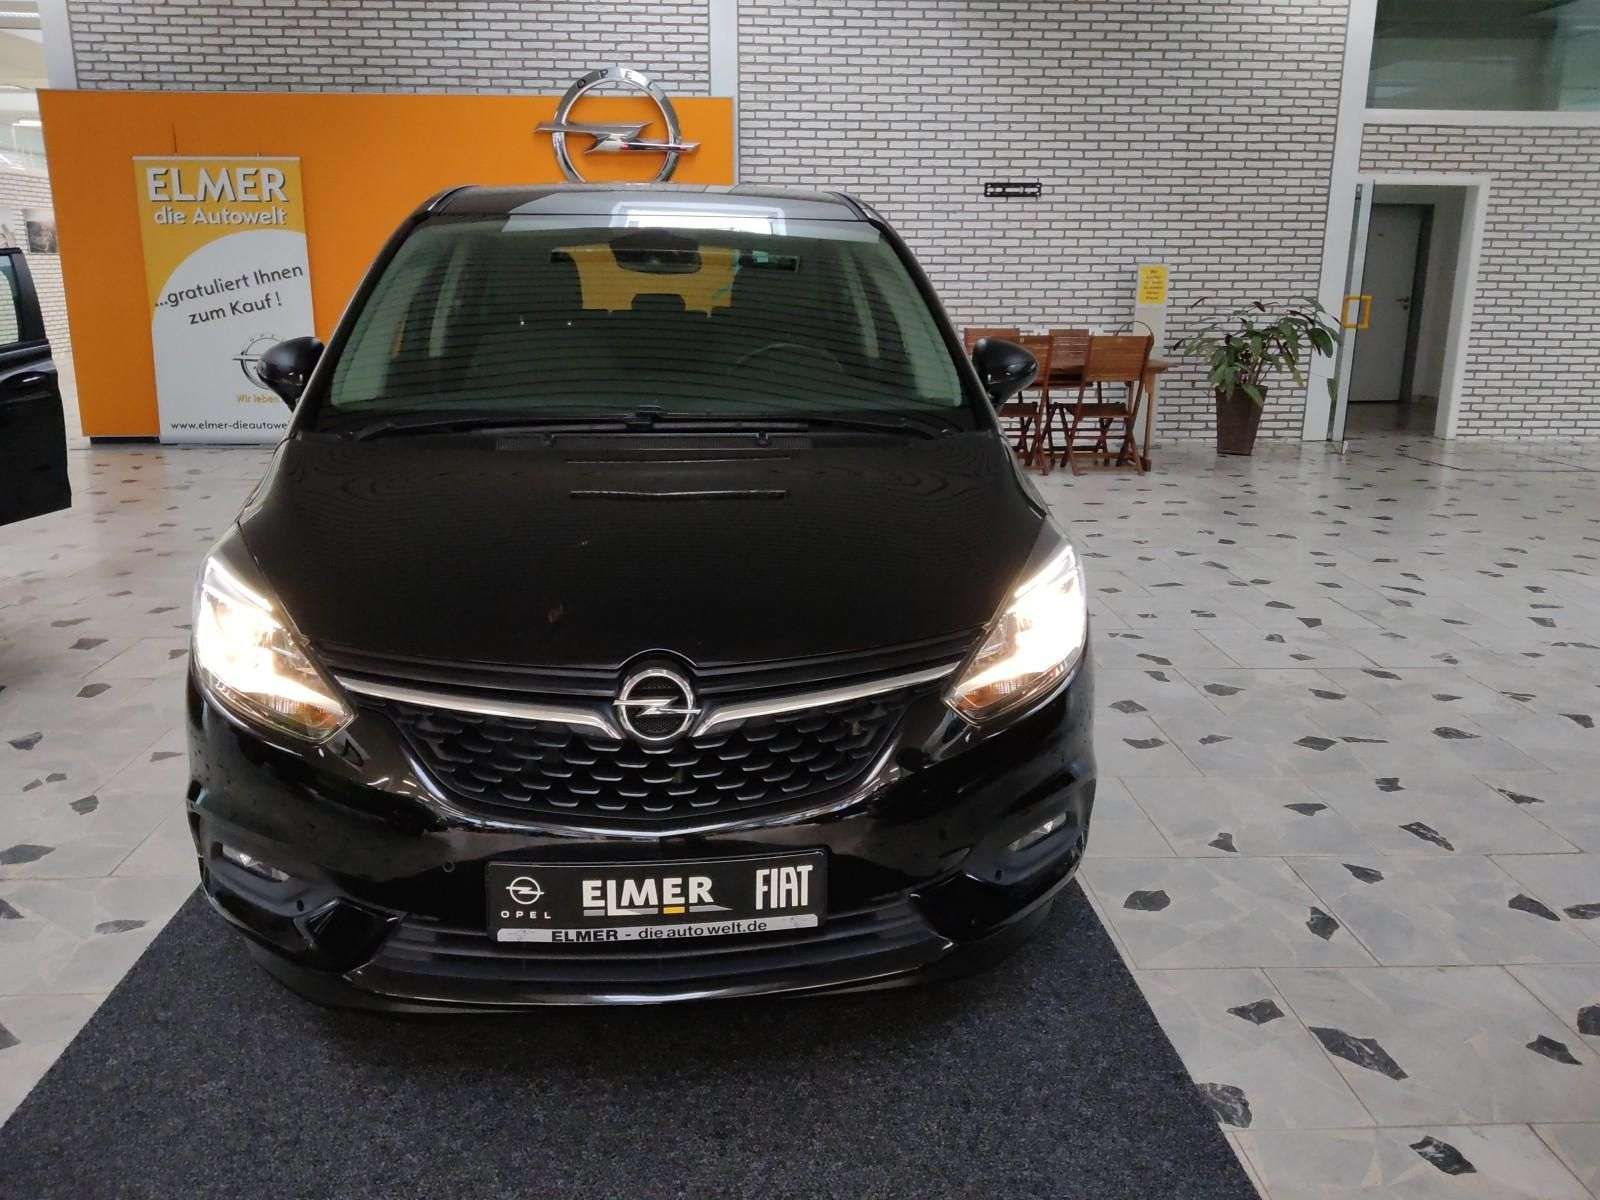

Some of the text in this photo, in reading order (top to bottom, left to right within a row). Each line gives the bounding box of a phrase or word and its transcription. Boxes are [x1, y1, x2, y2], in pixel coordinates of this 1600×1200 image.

[576, 68, 654, 90] OPEL
[146, 167, 288, 203] ELMER
[154, 206, 288, 226] die Autowelt
[254, 265, 304, 286] Ihnen
[189, 306, 226, 325] zum
[229, 292, 271, 317] Kauf
[171, 420, 290, 431] www.elmer-dieautowe
[582, 864, 813, 916] ELMER FIAT
[500, 910, 551, 919] OPEL
[551, 929, 618, 943] ELMER
